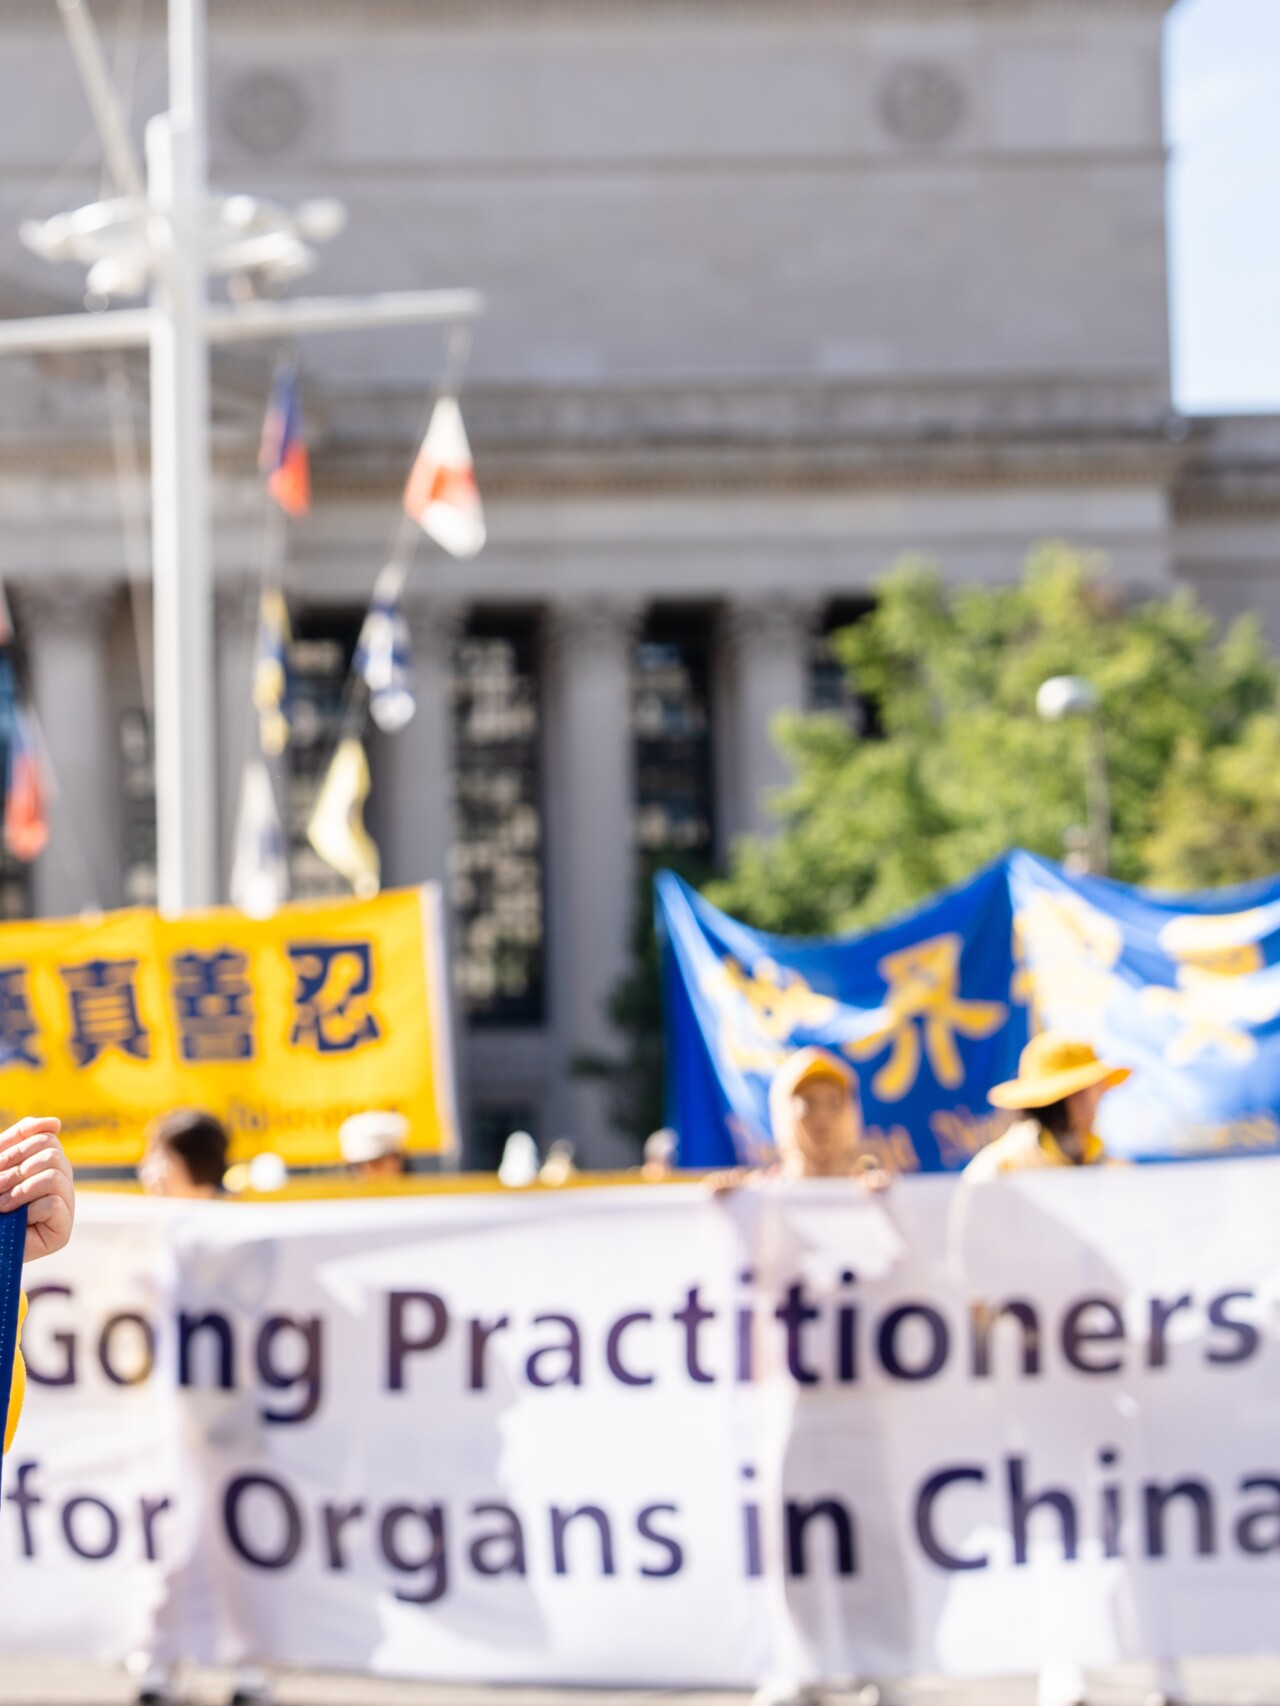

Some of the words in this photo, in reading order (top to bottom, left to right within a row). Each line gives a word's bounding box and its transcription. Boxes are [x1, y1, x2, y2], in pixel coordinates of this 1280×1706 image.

[23, 1284, 324, 1425] Gong
[384, 1268, 1262, 1392] Practitioners
[5, 1462, 171, 1560] for
[222, 1472, 685, 1603] Organs
[739, 1463, 857, 1578] in
[912, 1447, 1280, 1571] China
